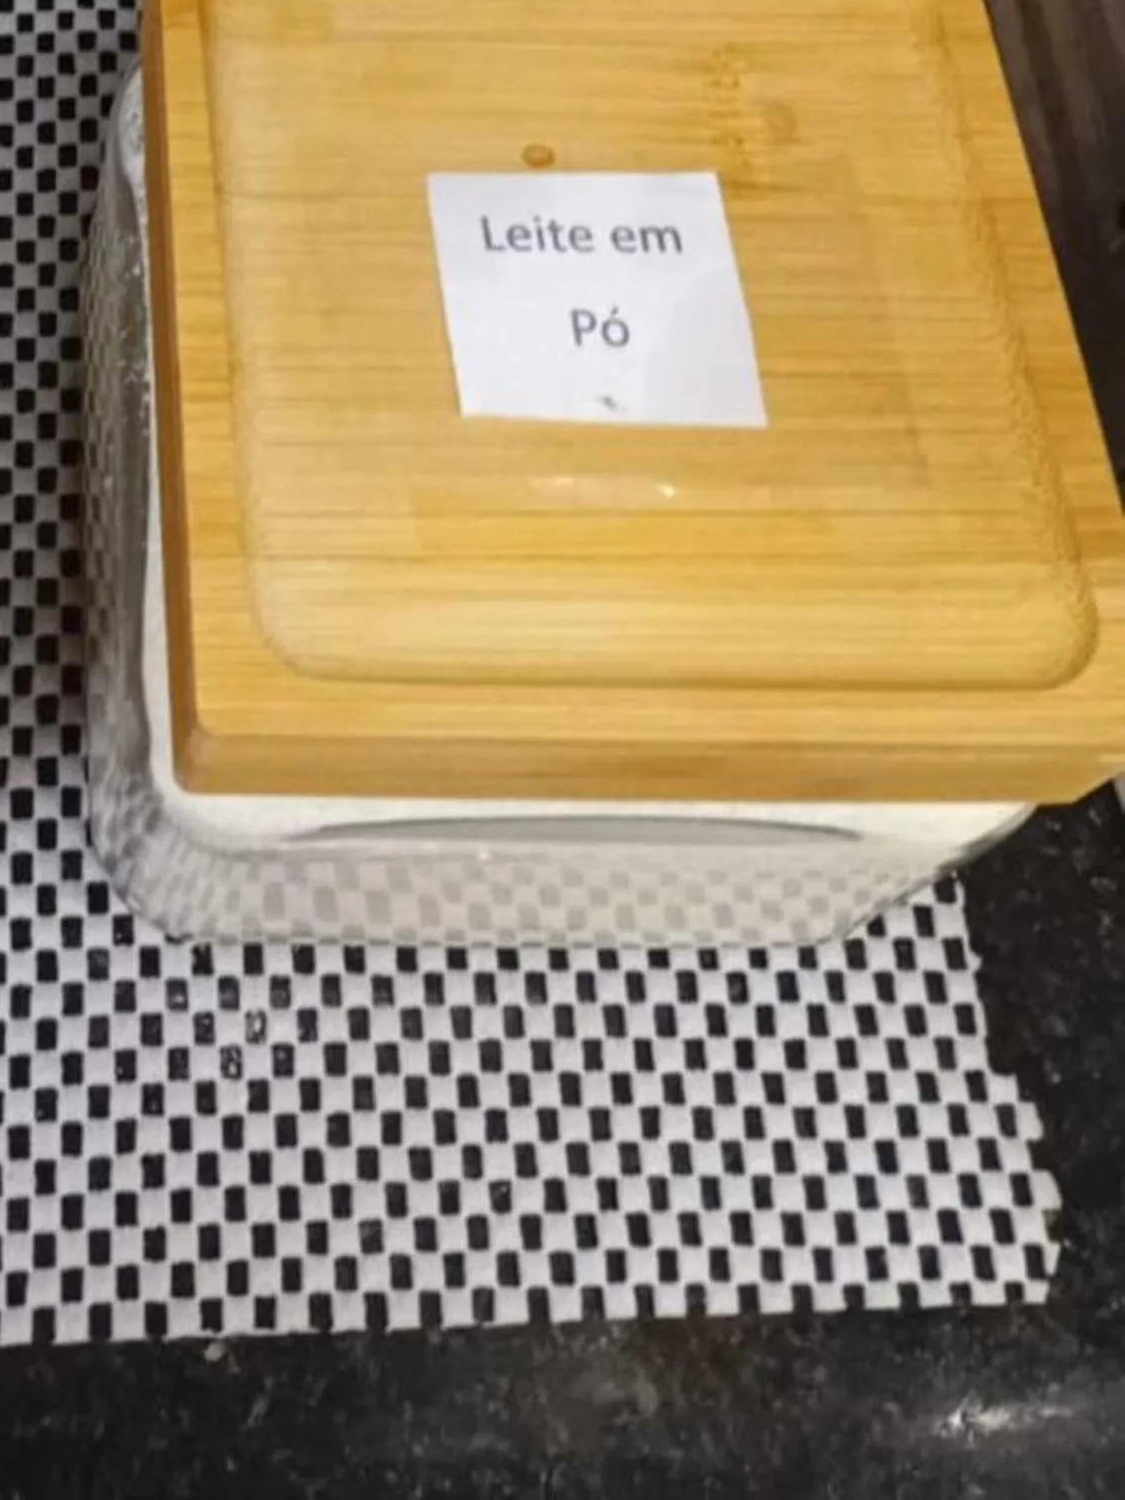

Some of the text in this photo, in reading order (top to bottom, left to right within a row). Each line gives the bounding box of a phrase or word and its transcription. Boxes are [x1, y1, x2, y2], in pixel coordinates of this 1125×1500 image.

[479, 213, 685, 255] Leite em
[569, 303, 632, 348] Pó
